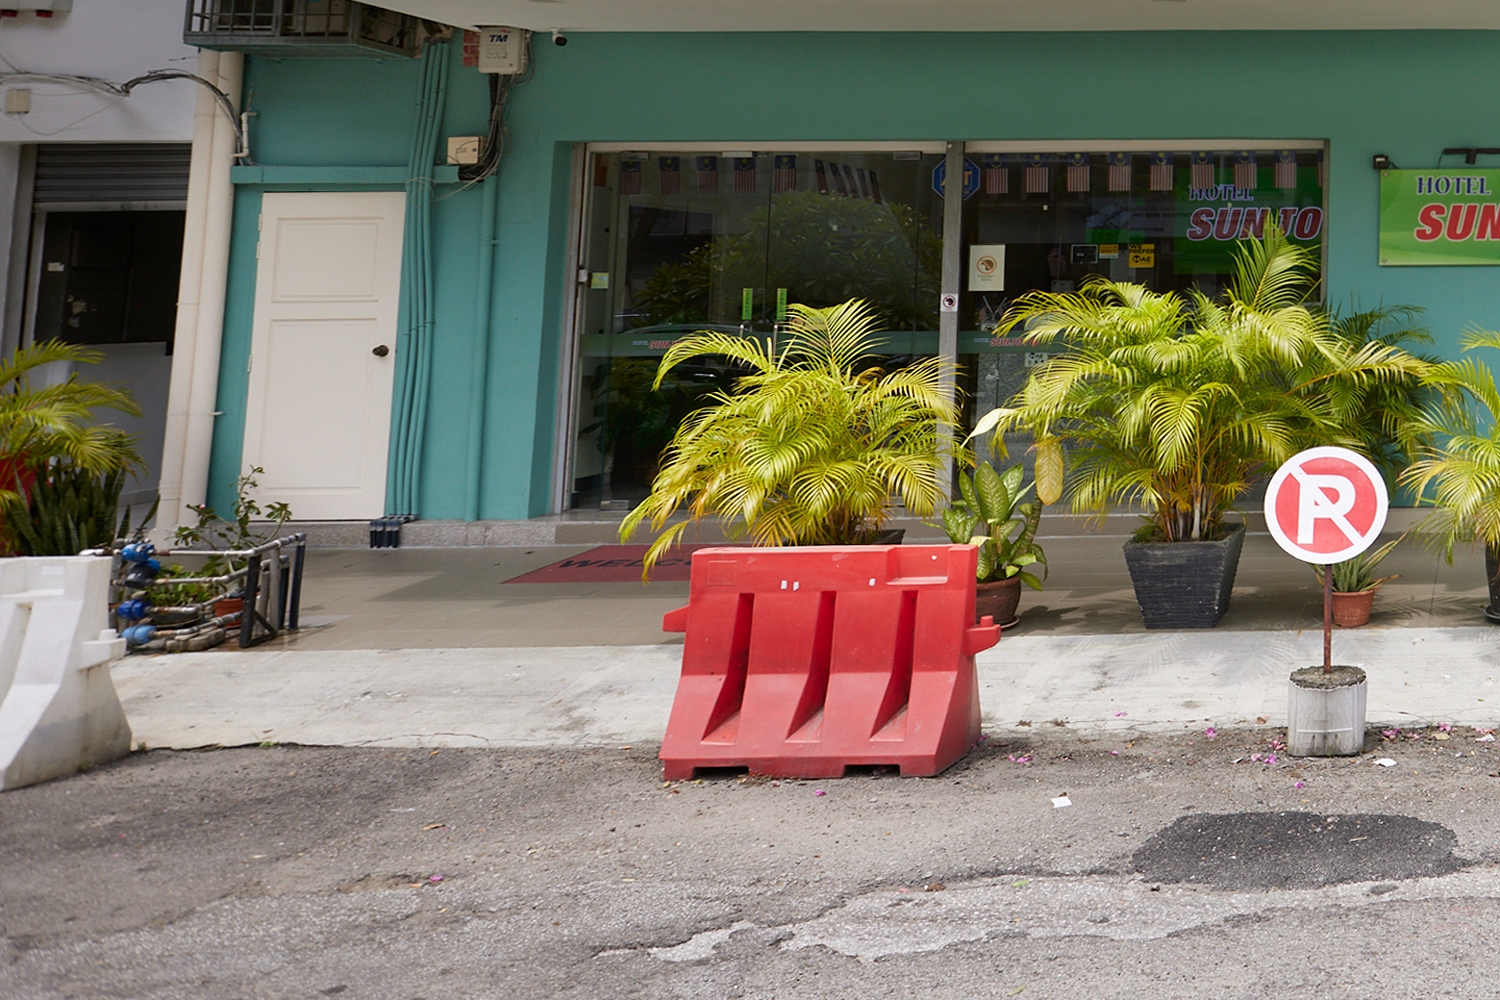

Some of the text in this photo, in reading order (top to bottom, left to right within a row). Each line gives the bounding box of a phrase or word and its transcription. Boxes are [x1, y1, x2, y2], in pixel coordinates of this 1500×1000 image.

[488, 34, 509, 43] TM
[1188, 183, 1255, 201] HOTEL
[1415, 175, 1492, 196] HOTEL
